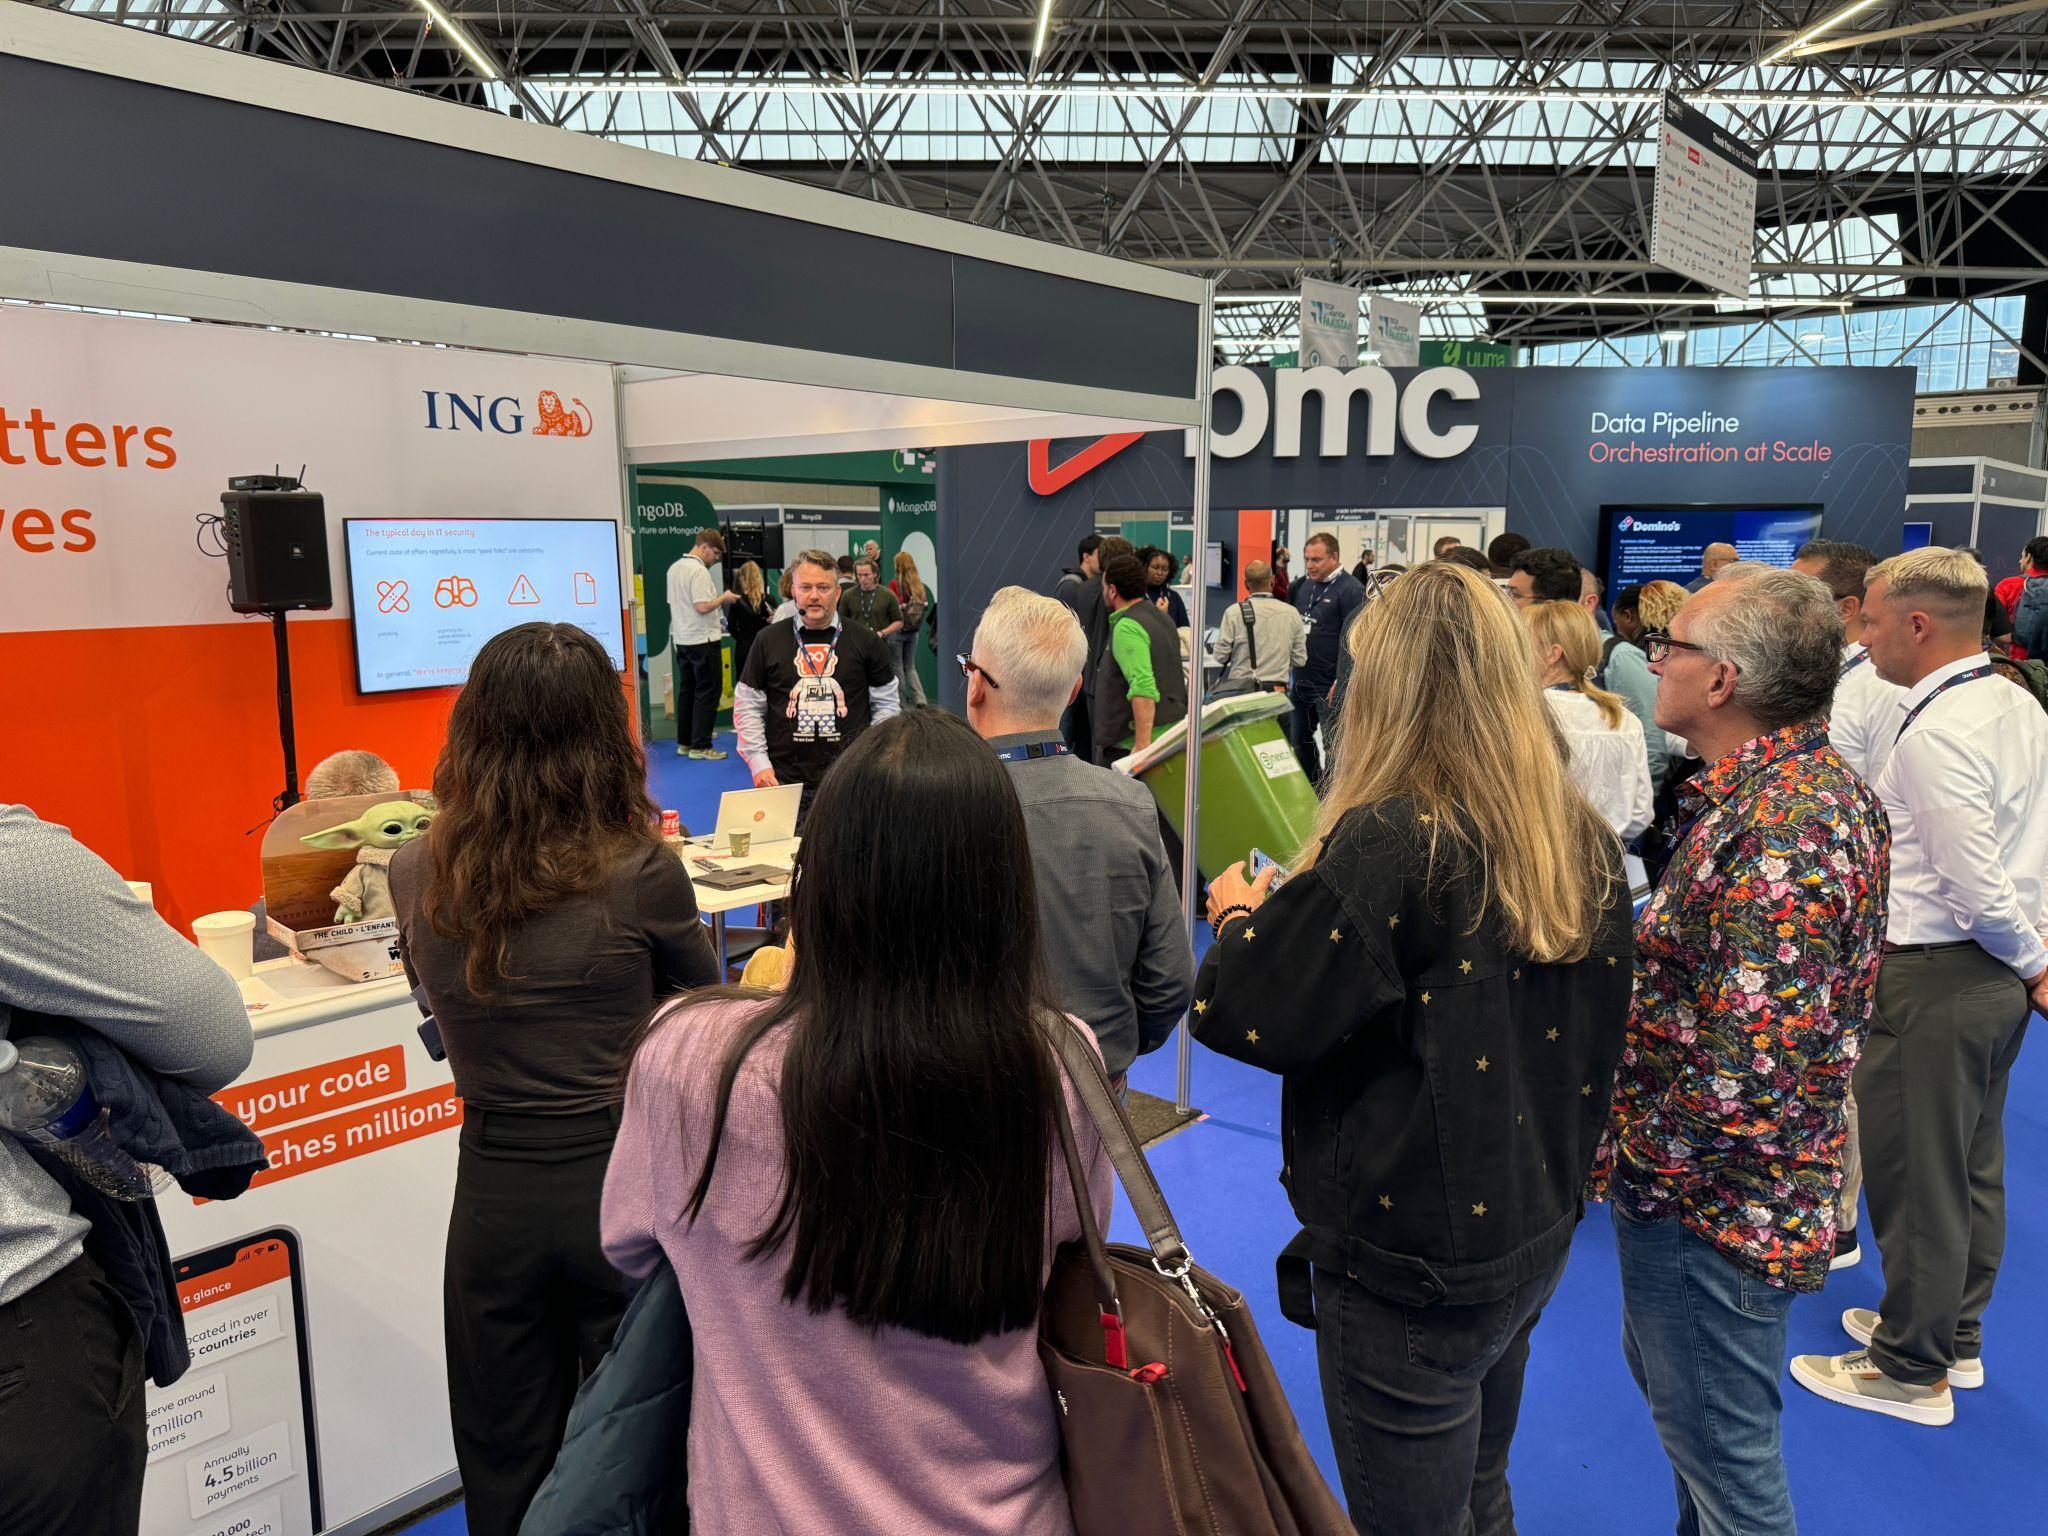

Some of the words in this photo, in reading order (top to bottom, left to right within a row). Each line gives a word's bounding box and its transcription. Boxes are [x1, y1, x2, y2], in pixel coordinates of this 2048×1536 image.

[422, 390, 524, 434] ING
[1591, 412, 1646, 433] Data
[1653, 411, 1739, 439] Pipeline
[1589, 440, 1738, 463] Orchestration
[1745, 441, 1767, 462] at
[1773, 440, 1832, 462] Scale
[896, 501, 937, 515] MongoDB
[0, 509, 96, 553] es
[366, 528, 380, 536] The
[382, 528, 409, 539] typical
[411, 528, 426, 538] day
[428, 528, 435, 536] in
[436, 528, 443, 536] IT
[444, 528, 475, 538] security
[1633, 521, 1681, 532] Domino's
[367, 548, 387, 556] Current
[377, 671, 383, 679] In
[998, 752, 1012, 760] mc
[314, 932, 329, 940] THE
[331, 928, 353, 937] CHILD
[361, 921, 395, 932] L'ENFANT
[237, 1082, 311, 1126] your
[320, 1060, 391, 1097] code
[267, 1134, 337, 1170] ches
[346, 1098, 457, 1146] millions
[183, 1296, 190, 1304] a
[194, 1282, 232, 1303] glance
[230, 1319, 241, 1330] in
[244, 1308, 269, 1325] over
[200, 1328, 257, 1355] countries
[146, 1402, 174, 1419] serve
[177, 1384, 216, 1406] around
[152, 1410, 203, 1437] million
[148, 1432, 186, 1454] omers
[204, 1446, 250, 1471] Annually
[205, 1466, 234, 1488] 4.5
[236, 1452, 277, 1477] billion
[208, 1474, 259, 1505] payments
